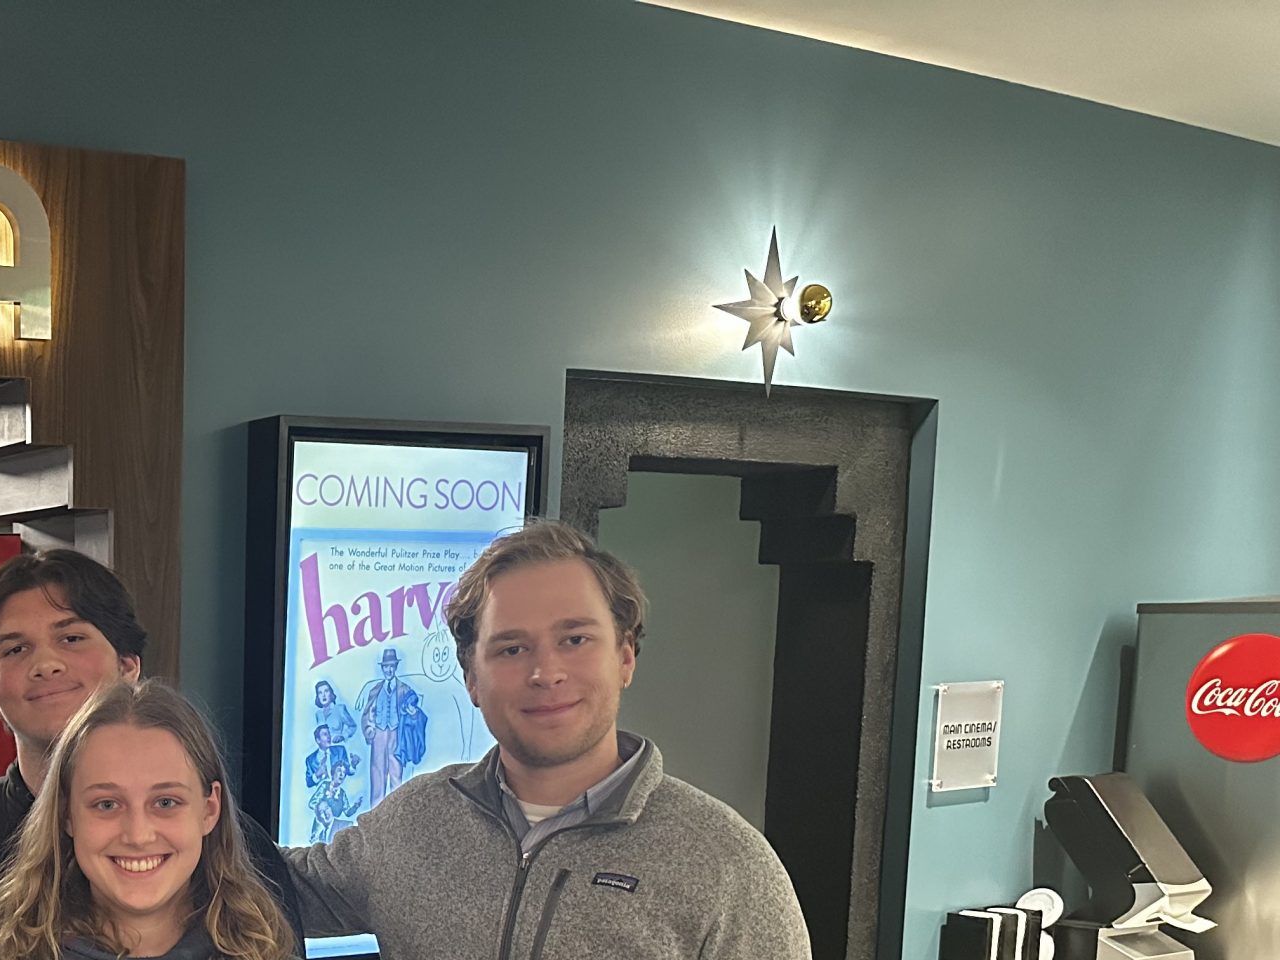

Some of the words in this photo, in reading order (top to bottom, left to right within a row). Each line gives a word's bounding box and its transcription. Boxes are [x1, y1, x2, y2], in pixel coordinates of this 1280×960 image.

[296, 473, 428, 509] COMING
[434, 479, 522, 512] SOON
[330, 547, 345, 557] The
[347, 547, 388, 558] Wonderful
[391, 549, 419, 559] Pulitzer
[422, 550, 441, 559] Prize
[329, 564, 344, 572] one
[346, 561, 356, 572] of
[358, 562, 371, 572] the
[373, 562, 396, 572] Great
[398, 563, 425, 573] Motion
[427, 563, 456, 573] Pictures
[943, 724, 962, 735] MAIN
[946, 736, 992, 750] RESTROOMS
[596, 878, 631, 889] patagonia
